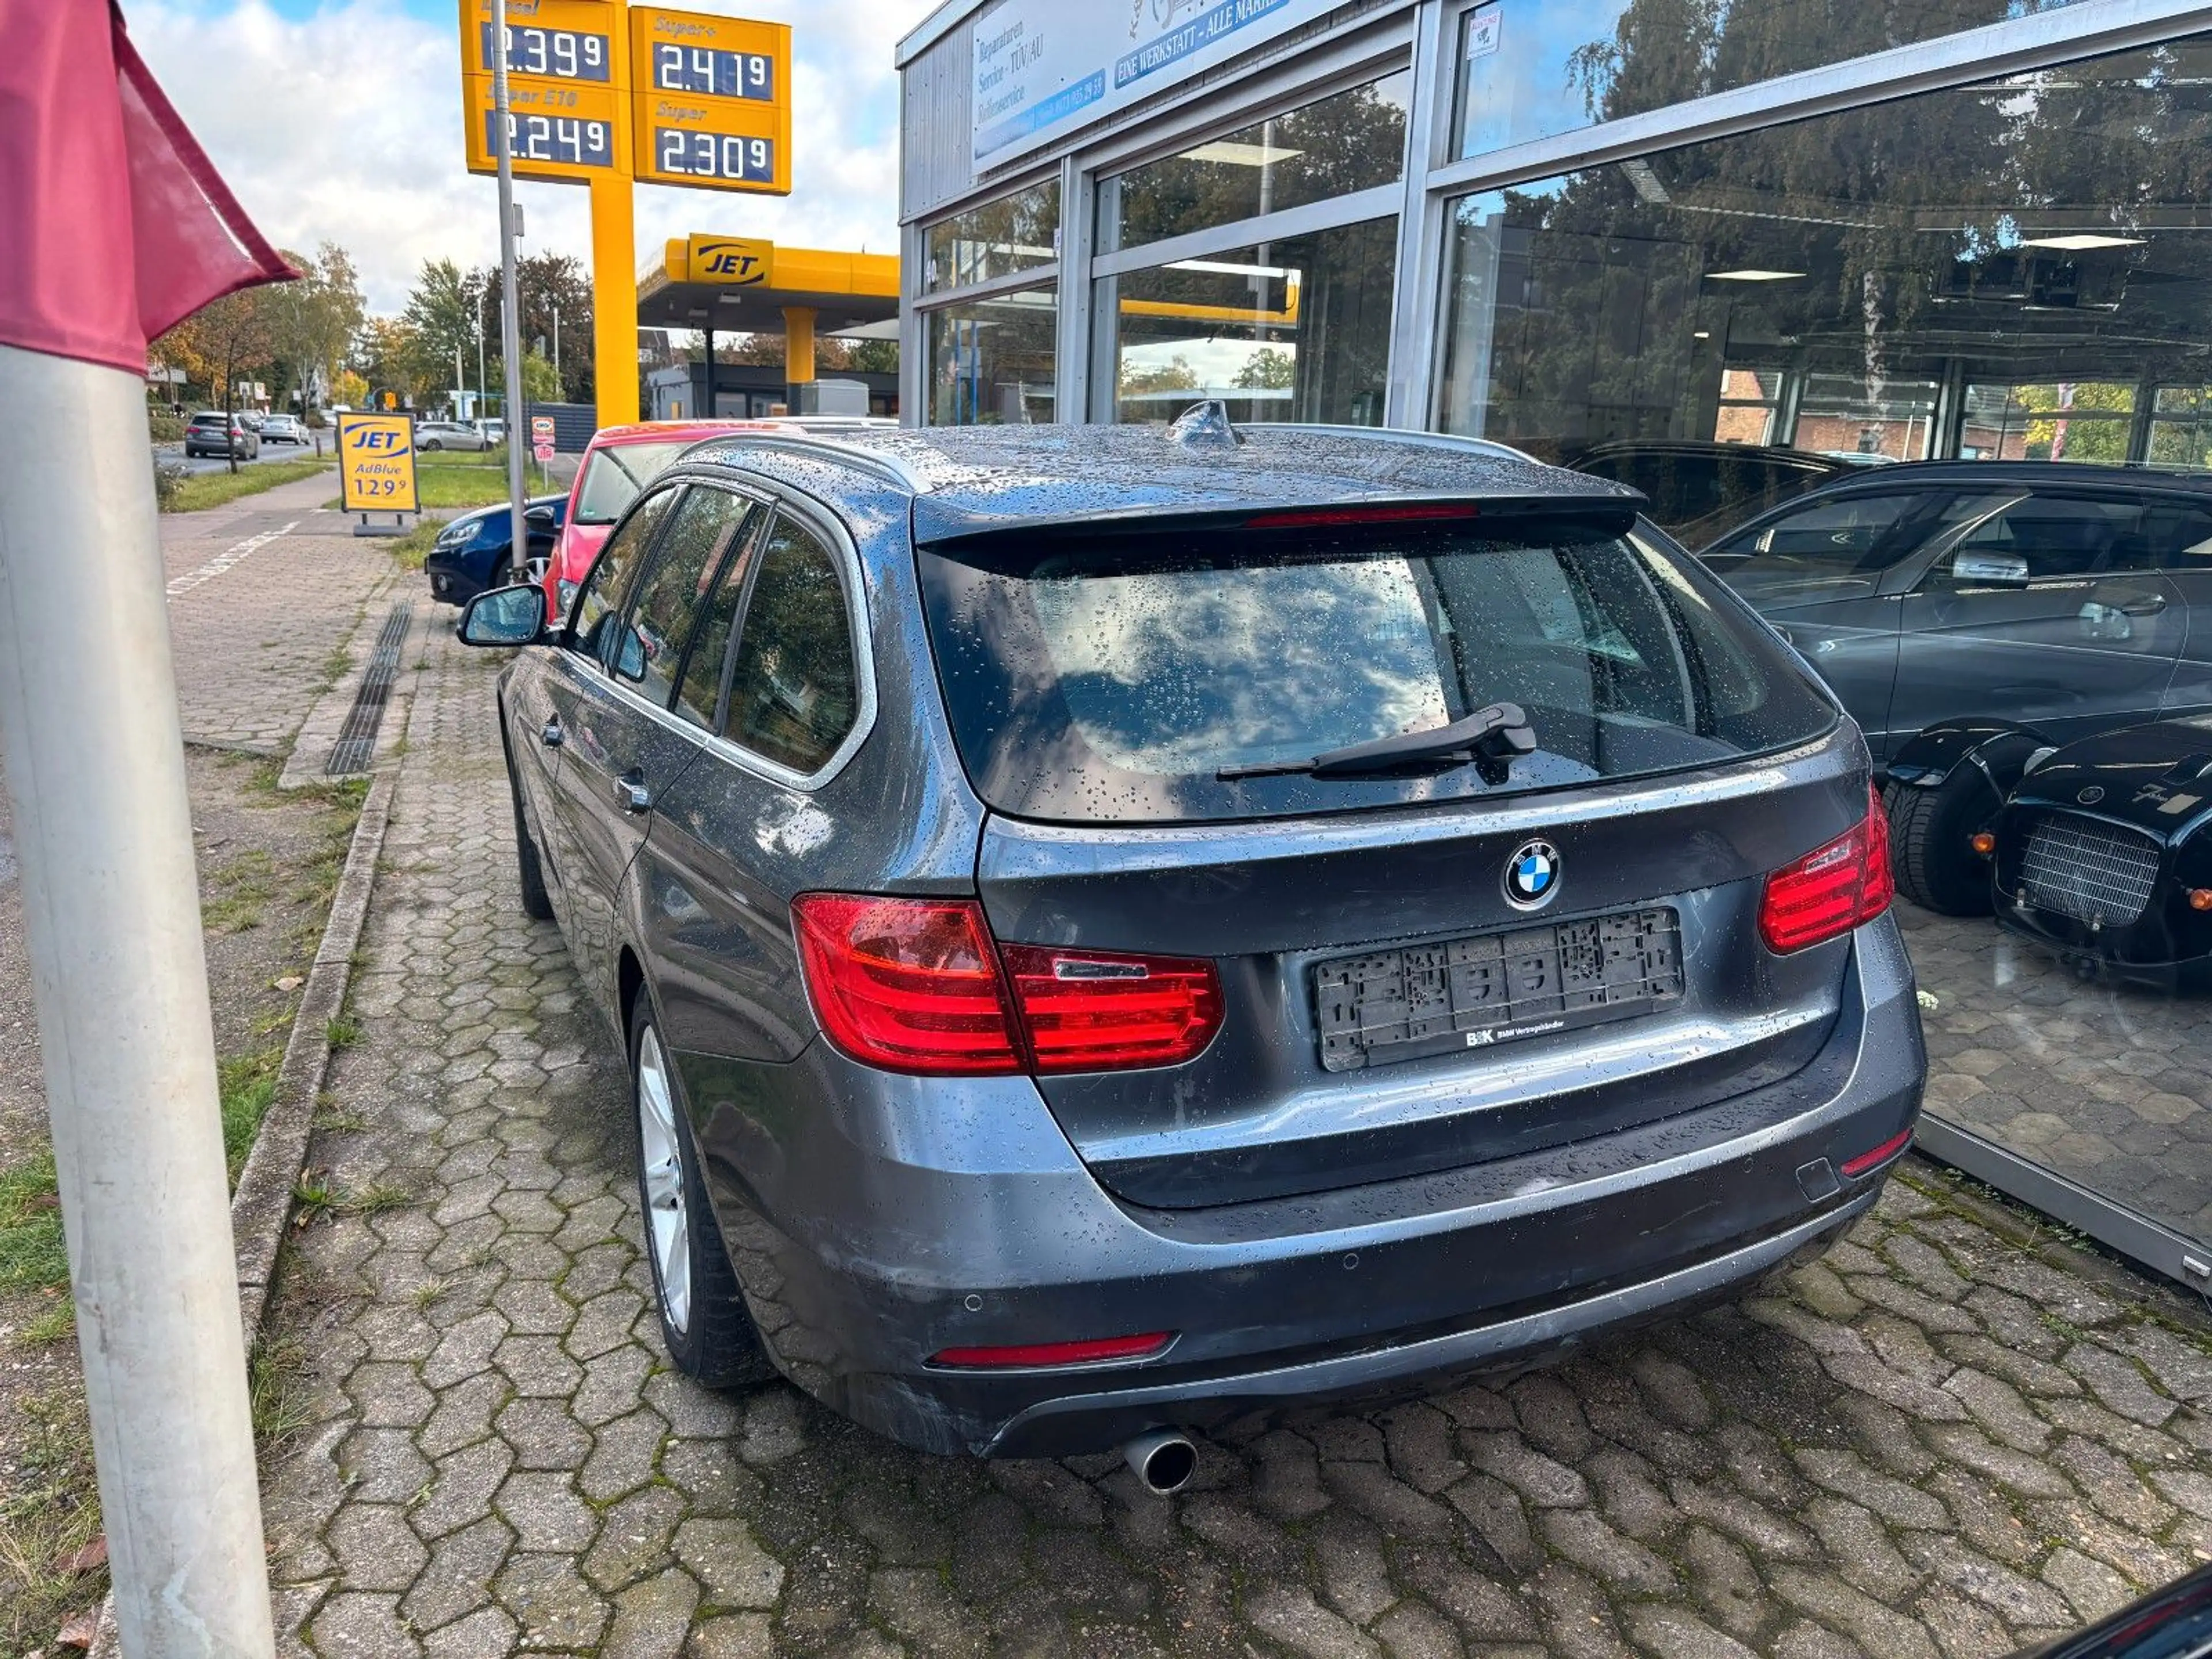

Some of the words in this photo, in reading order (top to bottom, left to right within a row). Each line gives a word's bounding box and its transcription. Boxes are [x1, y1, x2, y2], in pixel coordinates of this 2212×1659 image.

[482, 0, 539, 15] esel
[979, 21, 1023, 63] Reparaturen
[1118, 58, 1137, 82] EINE
[1139, 26, 1196, 73] WERKSTATT
[1206, 5, 1233, 39] ALLE
[979, 66, 1003, 94] Service
[485, 86, 539, 108] Sper
[543, 88, 578, 108] E10
[656, 101, 707, 123] Super
[704, 253, 759, 275] JET
[352, 431, 400, 449] JET
[355, 463, 402, 475] AdBlue
[1514, 844, 1558, 866] BMW
